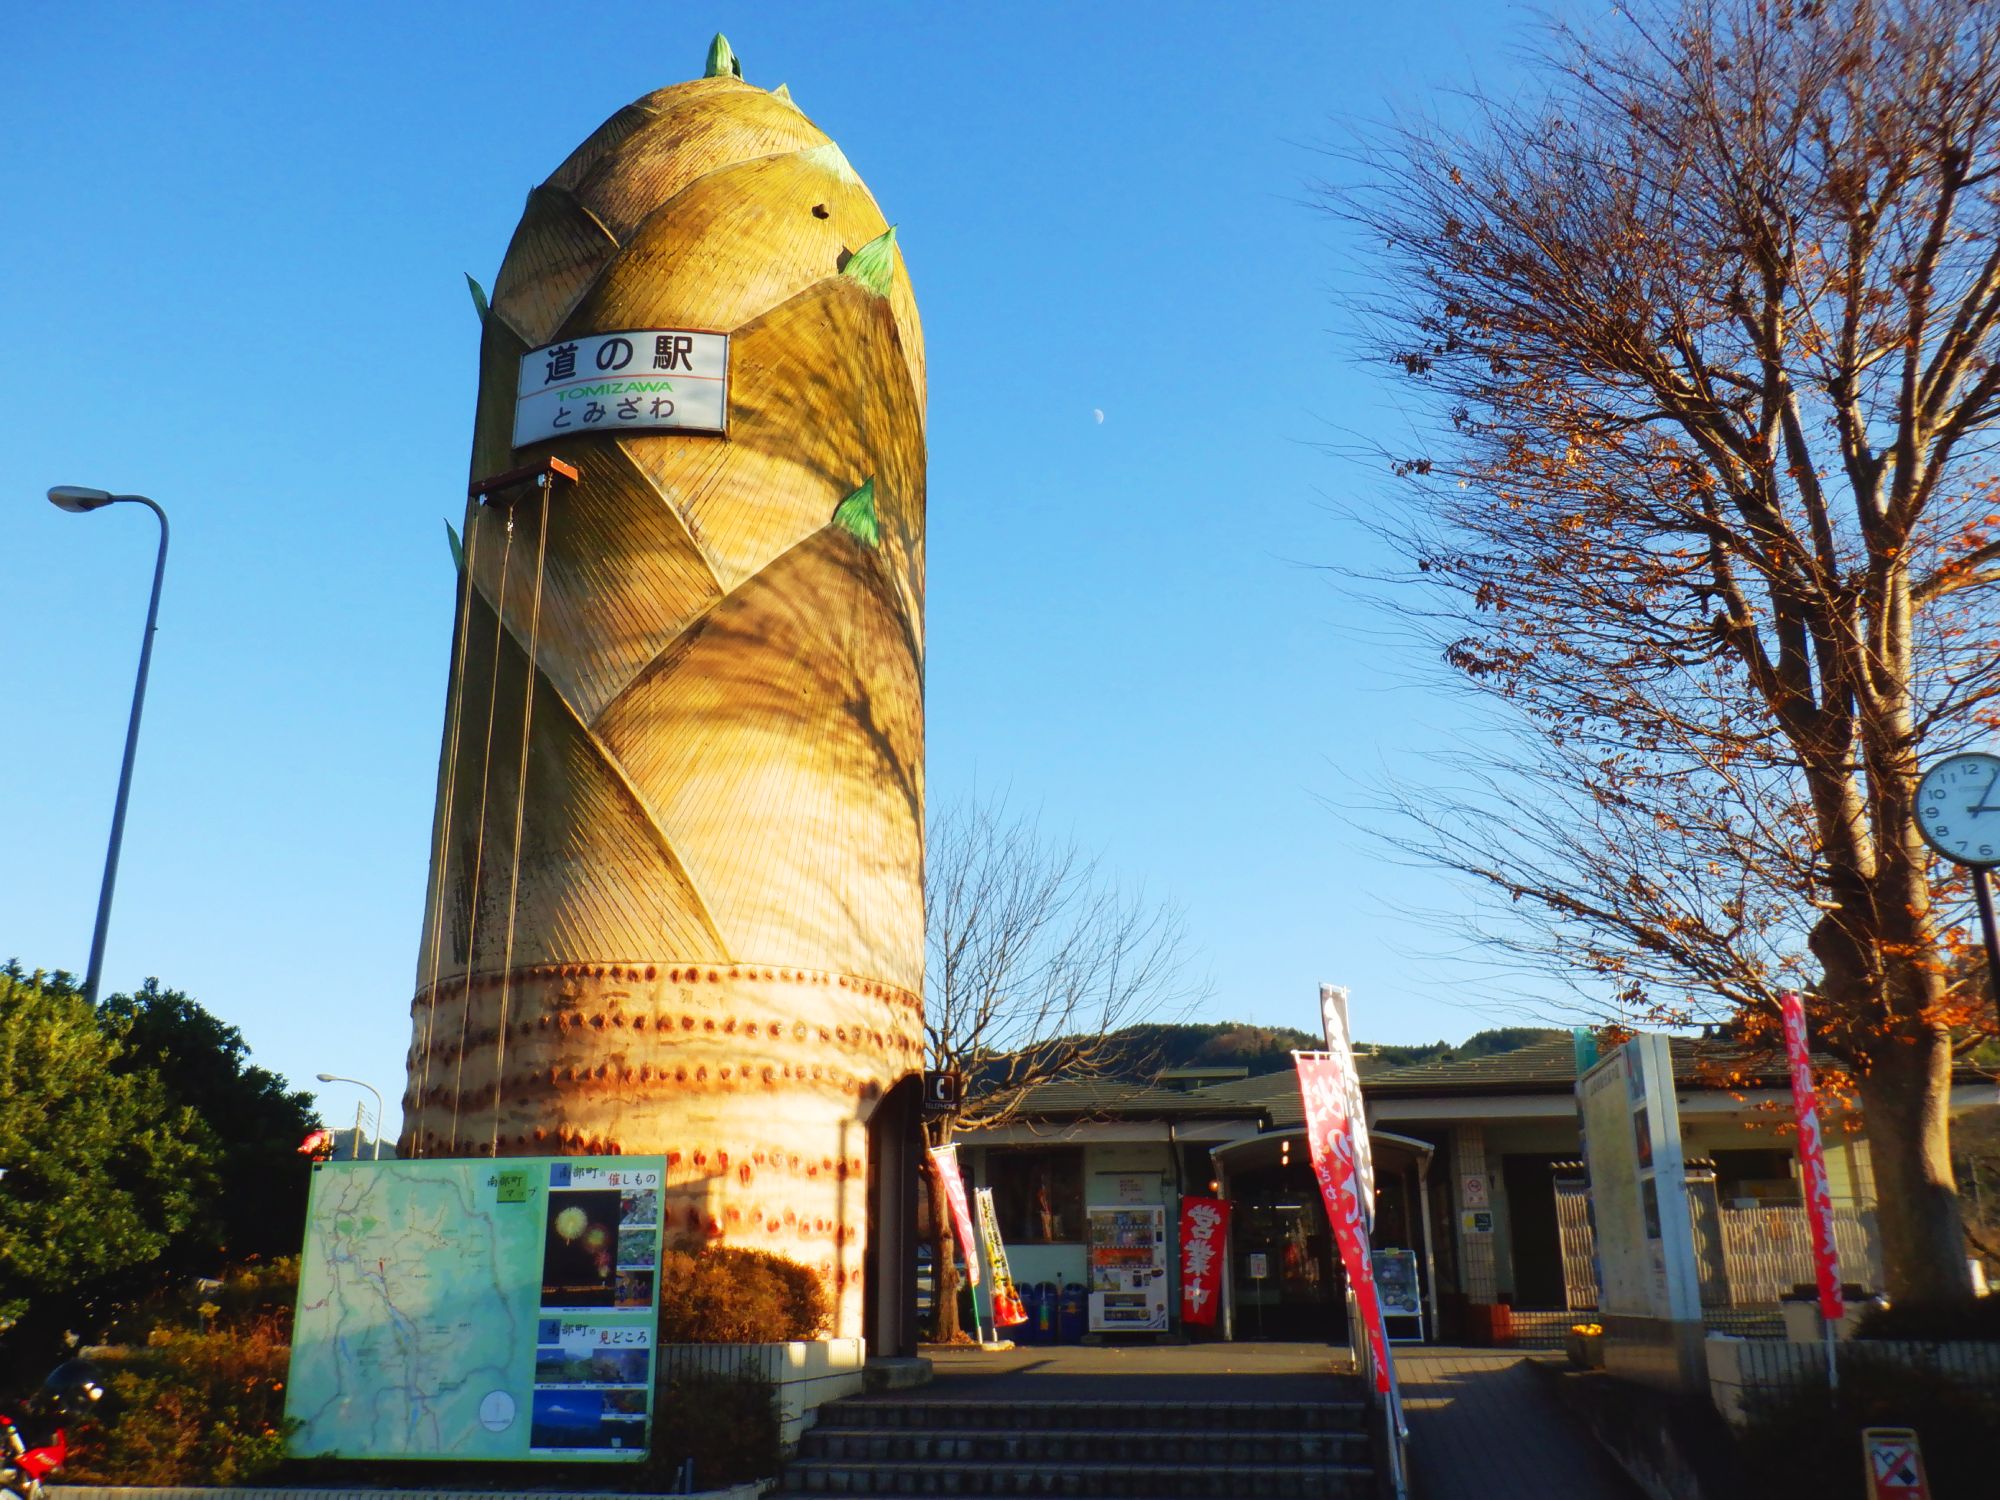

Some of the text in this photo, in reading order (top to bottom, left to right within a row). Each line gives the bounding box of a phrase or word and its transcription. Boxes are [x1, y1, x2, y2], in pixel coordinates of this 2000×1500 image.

[544, 334, 693, 386] 道の駅
[556, 381, 673, 402] TOMIZAWA
[552, 396, 675, 428] とみざわ
[1961, 763, 1979, 775] 12
[1940, 772, 1956, 784] 11
[1928, 789, 1946, 800] 10
[1925, 807, 1939, 818] 9
[1936, 825, 1949, 837] 8
[1955, 841, 1968, 852] 7
[1979, 844, 1993, 856] 6
[487, 1175, 523, 1188] 南部町
[1183, 1204, 1221, 1314] 営業中
